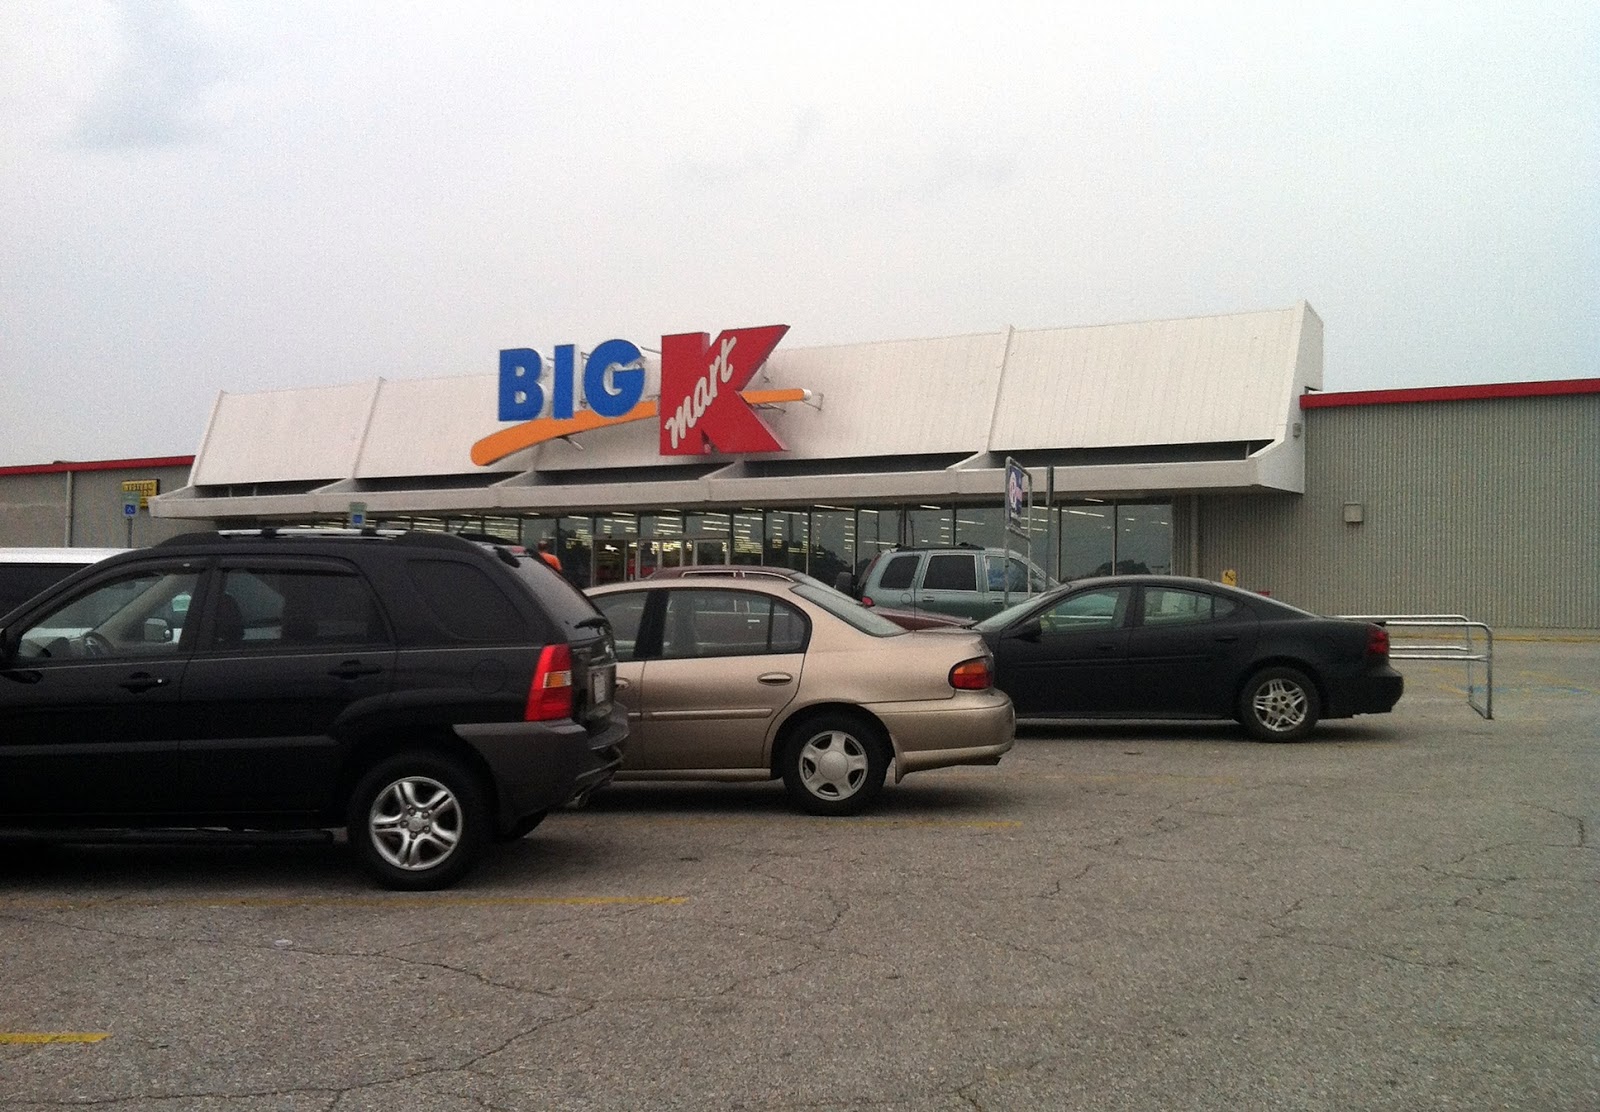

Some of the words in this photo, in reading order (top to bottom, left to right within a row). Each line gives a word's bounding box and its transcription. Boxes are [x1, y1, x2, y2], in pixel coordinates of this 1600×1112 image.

[498, 339, 645, 421] BIG
[660, 325, 790, 455] K
[665, 337, 737, 449] mart
